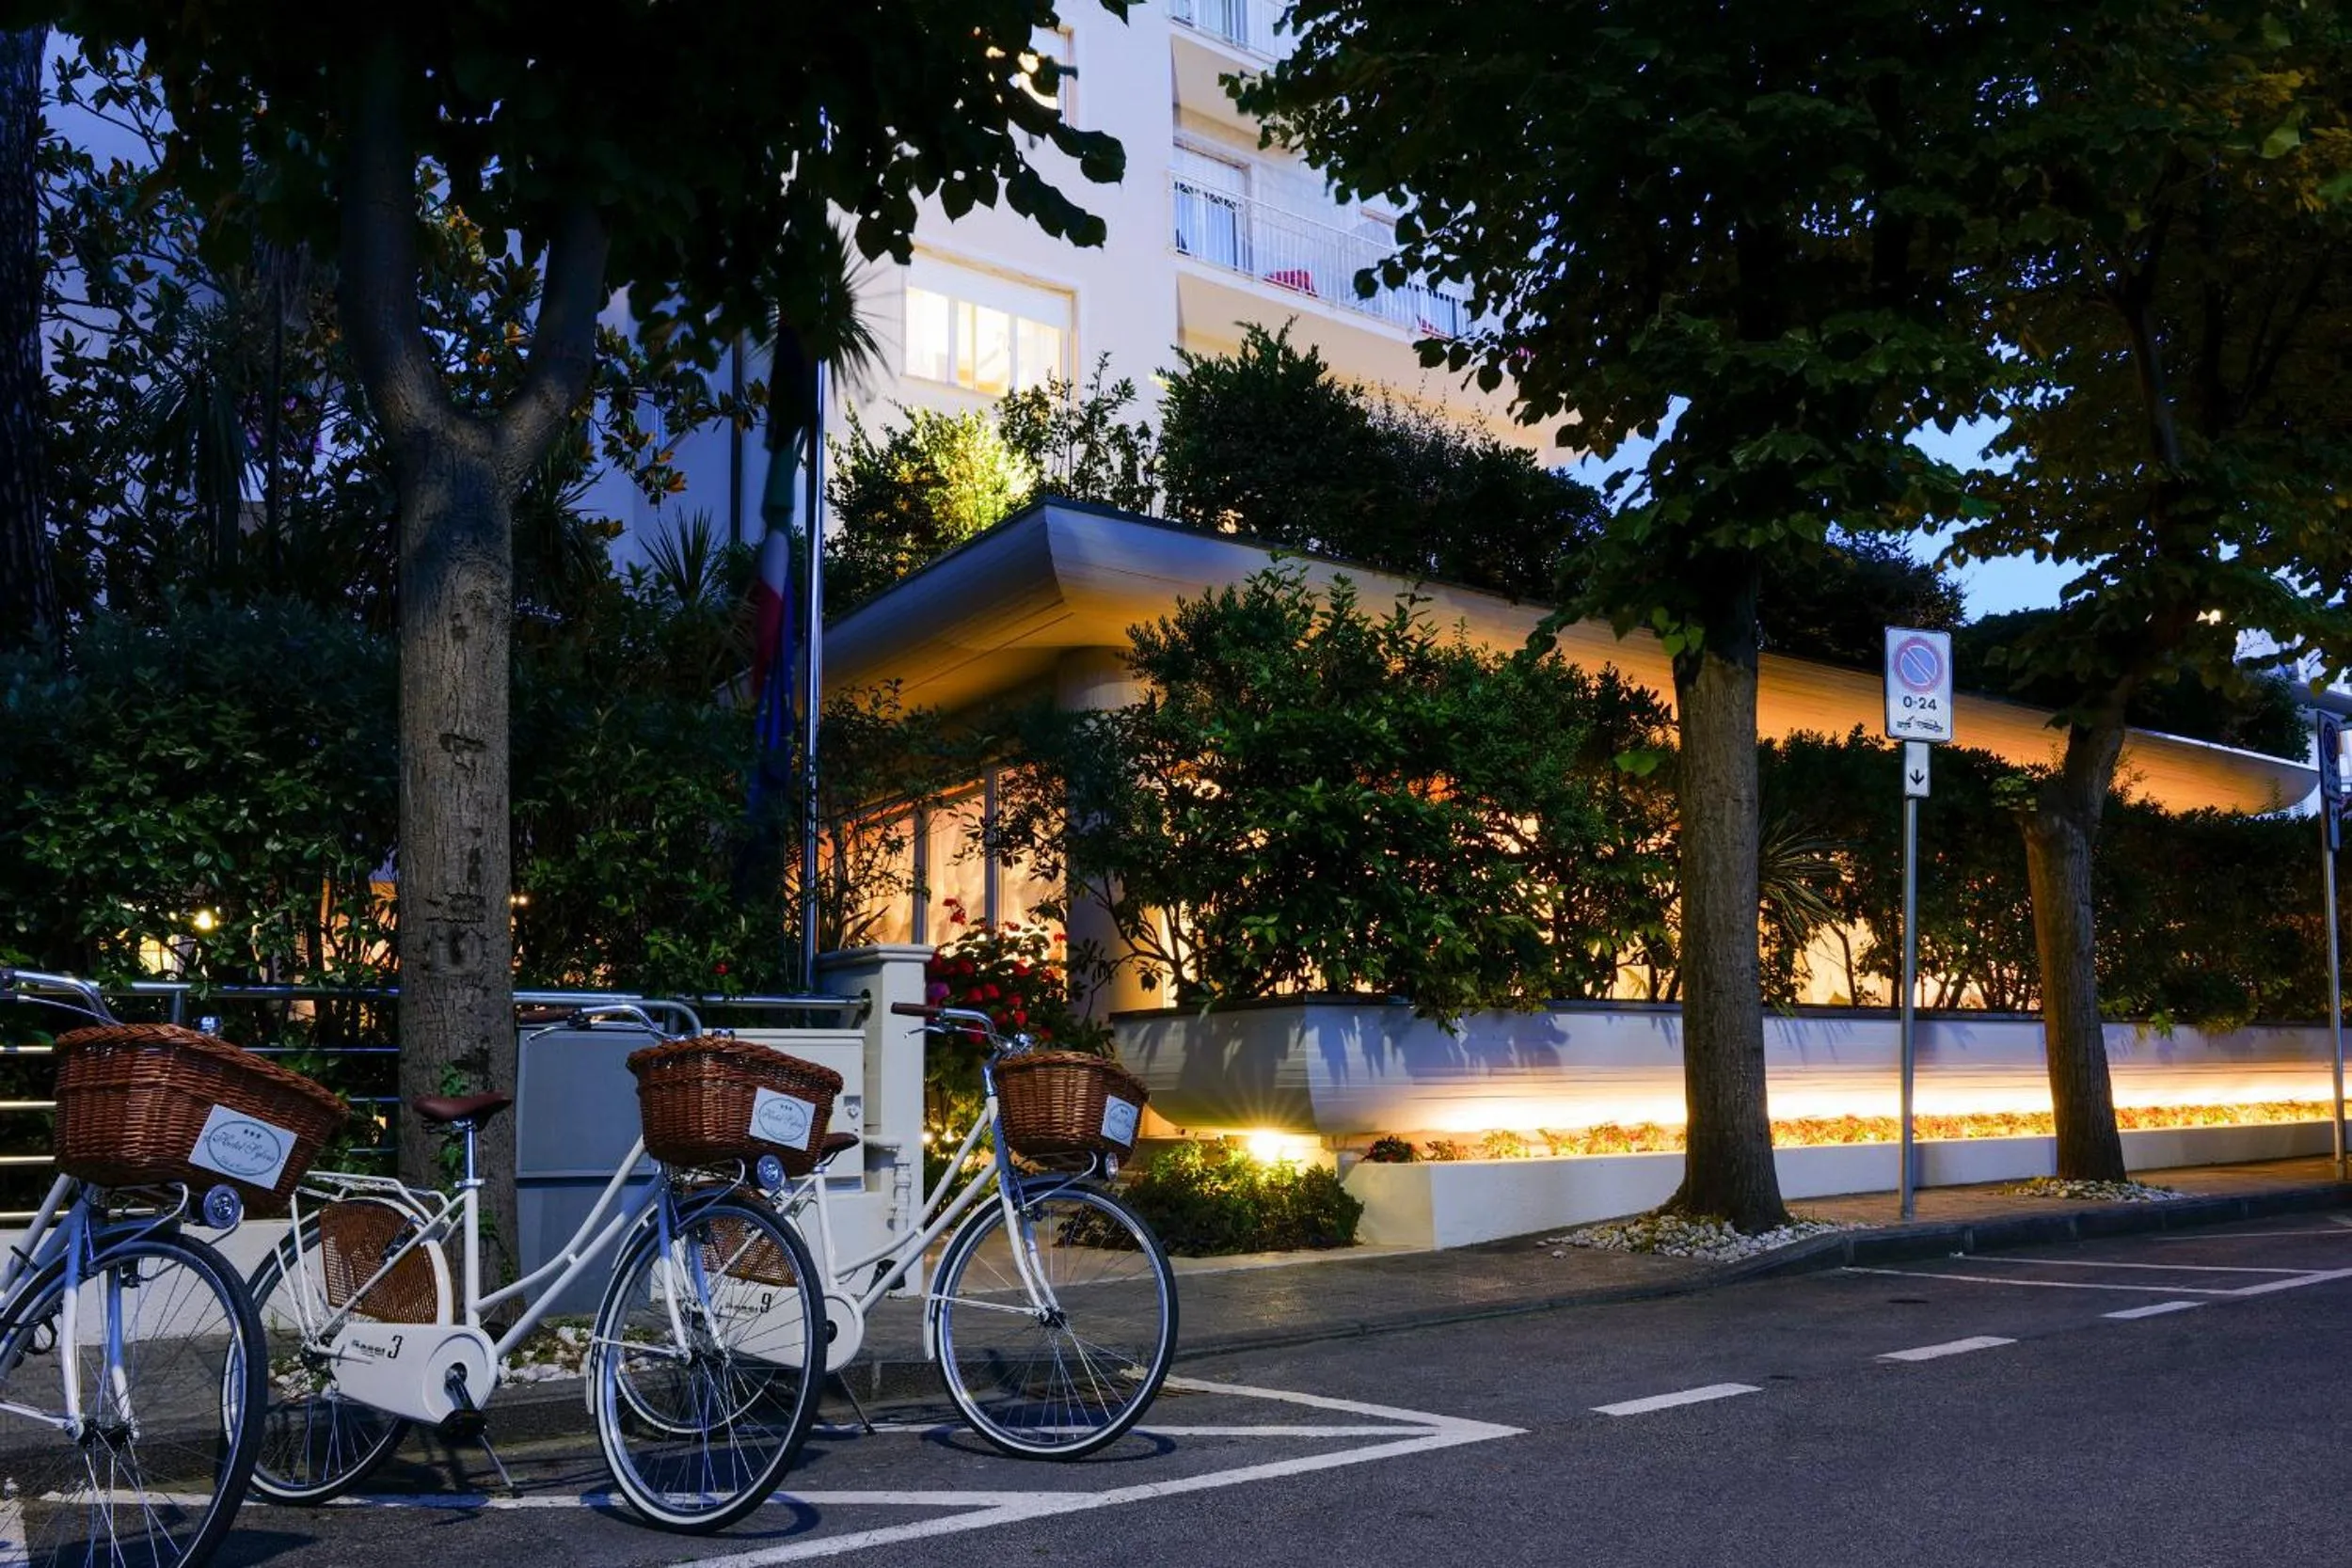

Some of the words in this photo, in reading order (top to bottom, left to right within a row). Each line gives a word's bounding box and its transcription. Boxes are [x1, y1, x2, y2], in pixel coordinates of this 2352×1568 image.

[1902, 695, 1938, 711] 0-24
[759, 1291, 772, 1314] 9
[387, 1334, 404, 1359] 3
